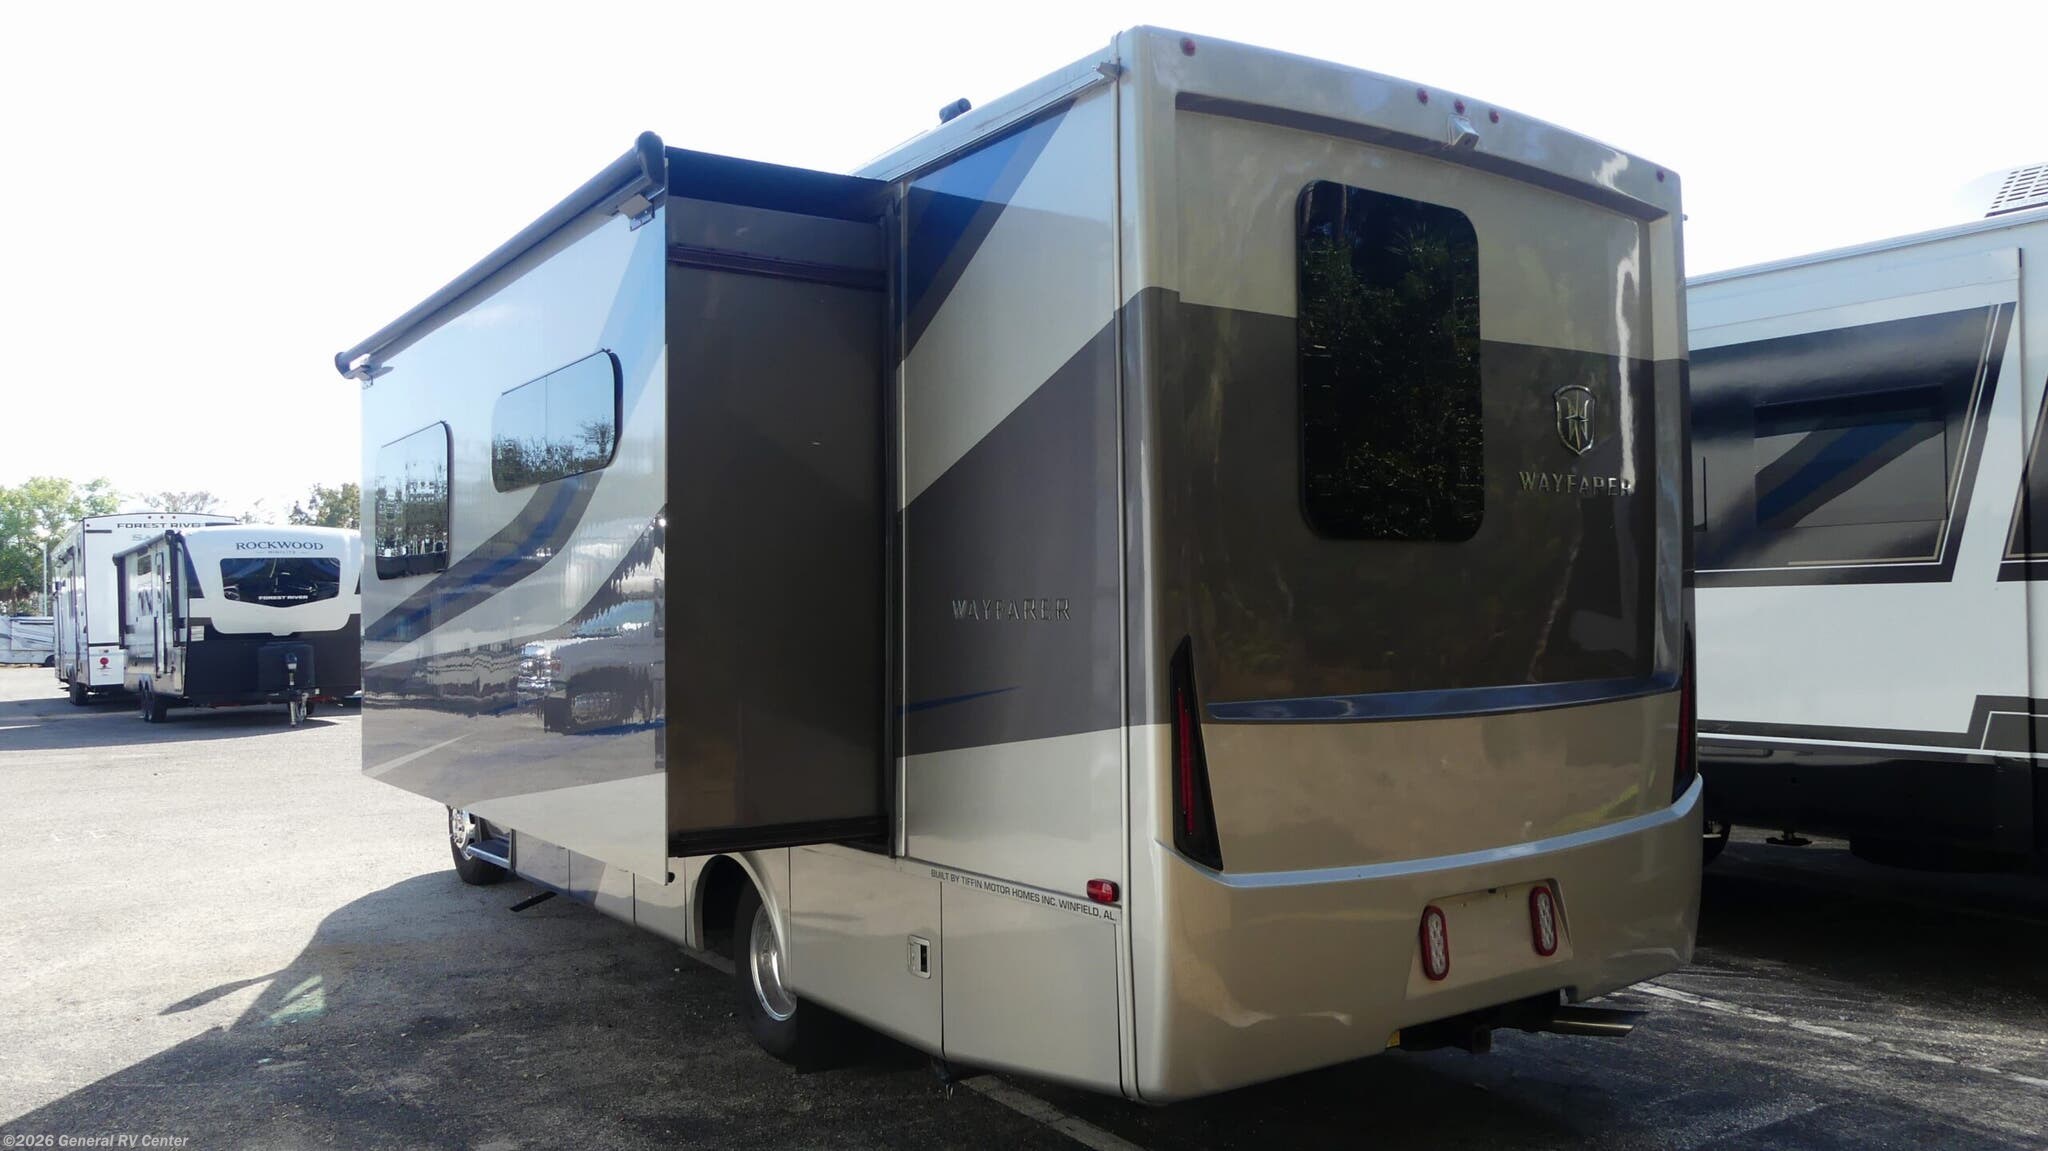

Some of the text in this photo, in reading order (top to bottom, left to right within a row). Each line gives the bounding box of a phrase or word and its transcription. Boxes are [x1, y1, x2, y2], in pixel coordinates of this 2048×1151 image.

[236, 541, 324, 550] ROCKWOOD
[952, 599, 1070, 621] WAYFARER
[930, 868, 949, 881] BUILT
[950, 874, 960, 883] BY
[961, 876, 982, 889] TIFFIN
[984, 882, 1011, 895] MOTOR
[1012, 888, 1040, 903] HOMES
[1042, 895, 1058, 907] INC.
[1059, 898, 1102, 918] WINFIELD,
